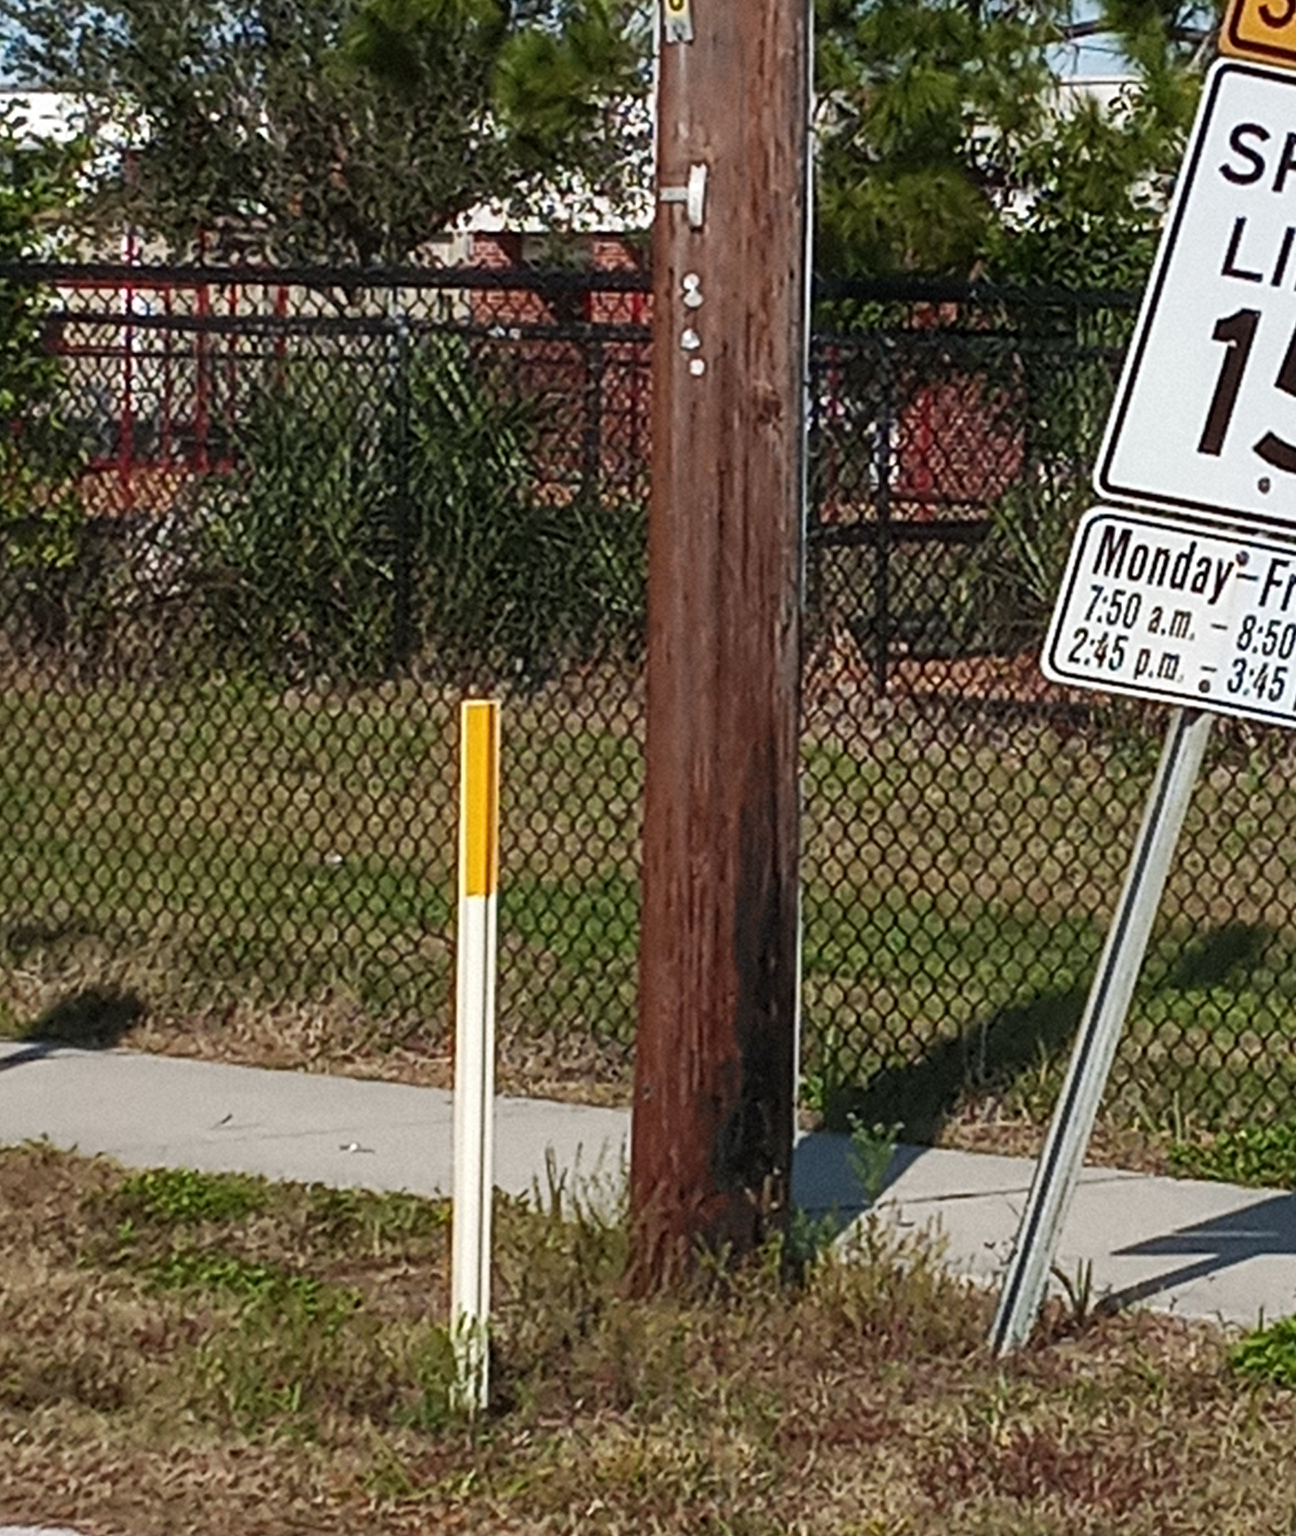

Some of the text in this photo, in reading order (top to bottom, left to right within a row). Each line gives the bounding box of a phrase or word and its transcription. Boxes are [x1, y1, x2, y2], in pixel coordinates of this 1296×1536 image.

[1084, 585, 1142, 629] 7:50
[1148, 606, 1196, 641] a.m.
[1068, 628, 1129, 671] 2:45
[1227, 658, 1289, 703] 3:45
